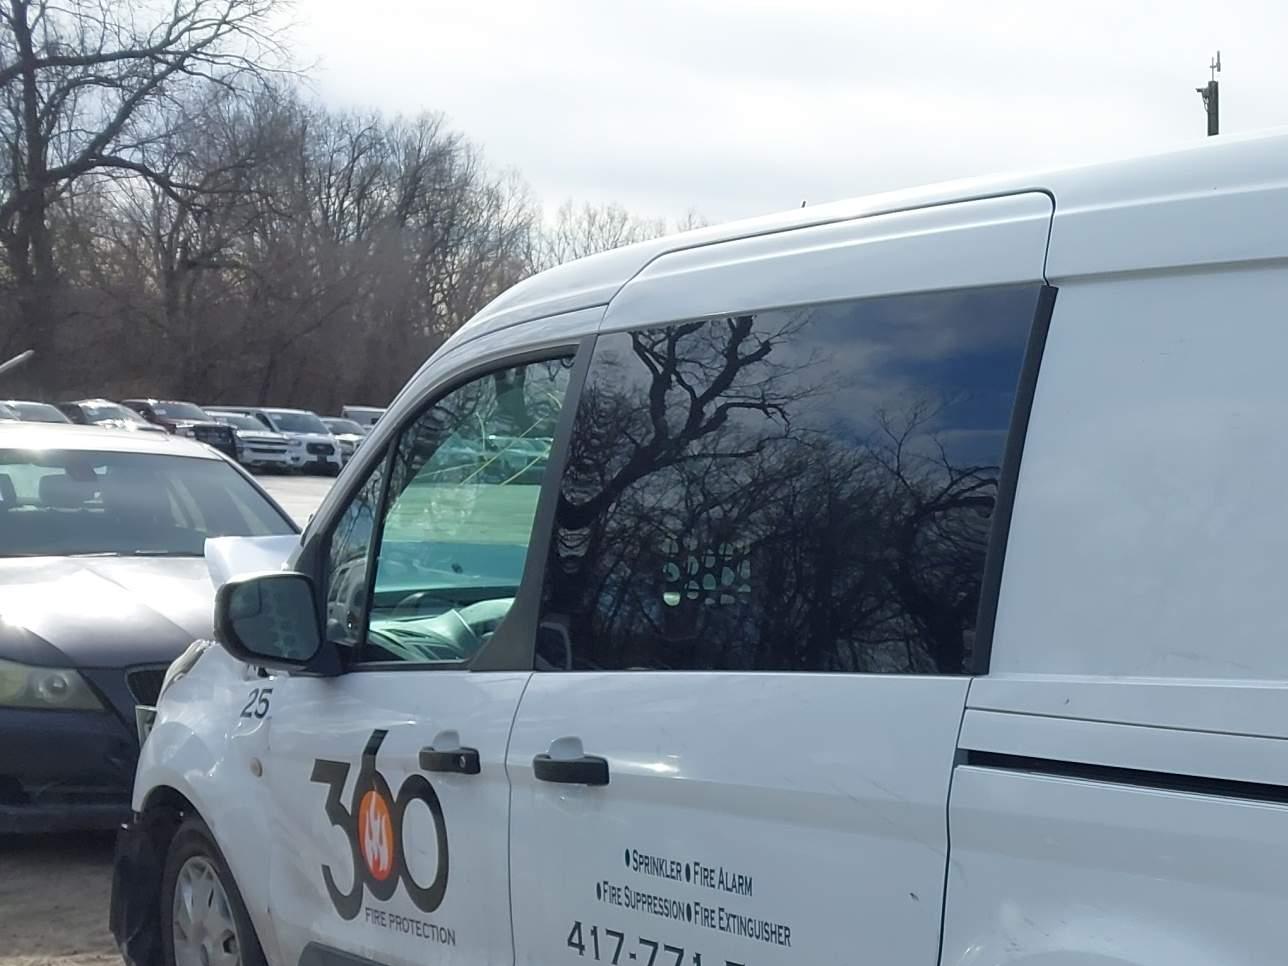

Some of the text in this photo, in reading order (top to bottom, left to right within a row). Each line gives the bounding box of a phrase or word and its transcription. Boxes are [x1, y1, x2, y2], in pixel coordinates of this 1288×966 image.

[239, 687, 273, 719] 25
[310, 729, 449, 921] 360
[693, 861, 716, 889] FIRE
[717, 866, 753, 896] ALARM
[602, 880, 622, 906] FIRE
[694, 901, 717, 929] FIRE
[365, 906, 456, 947] FIRE PROTECTION
